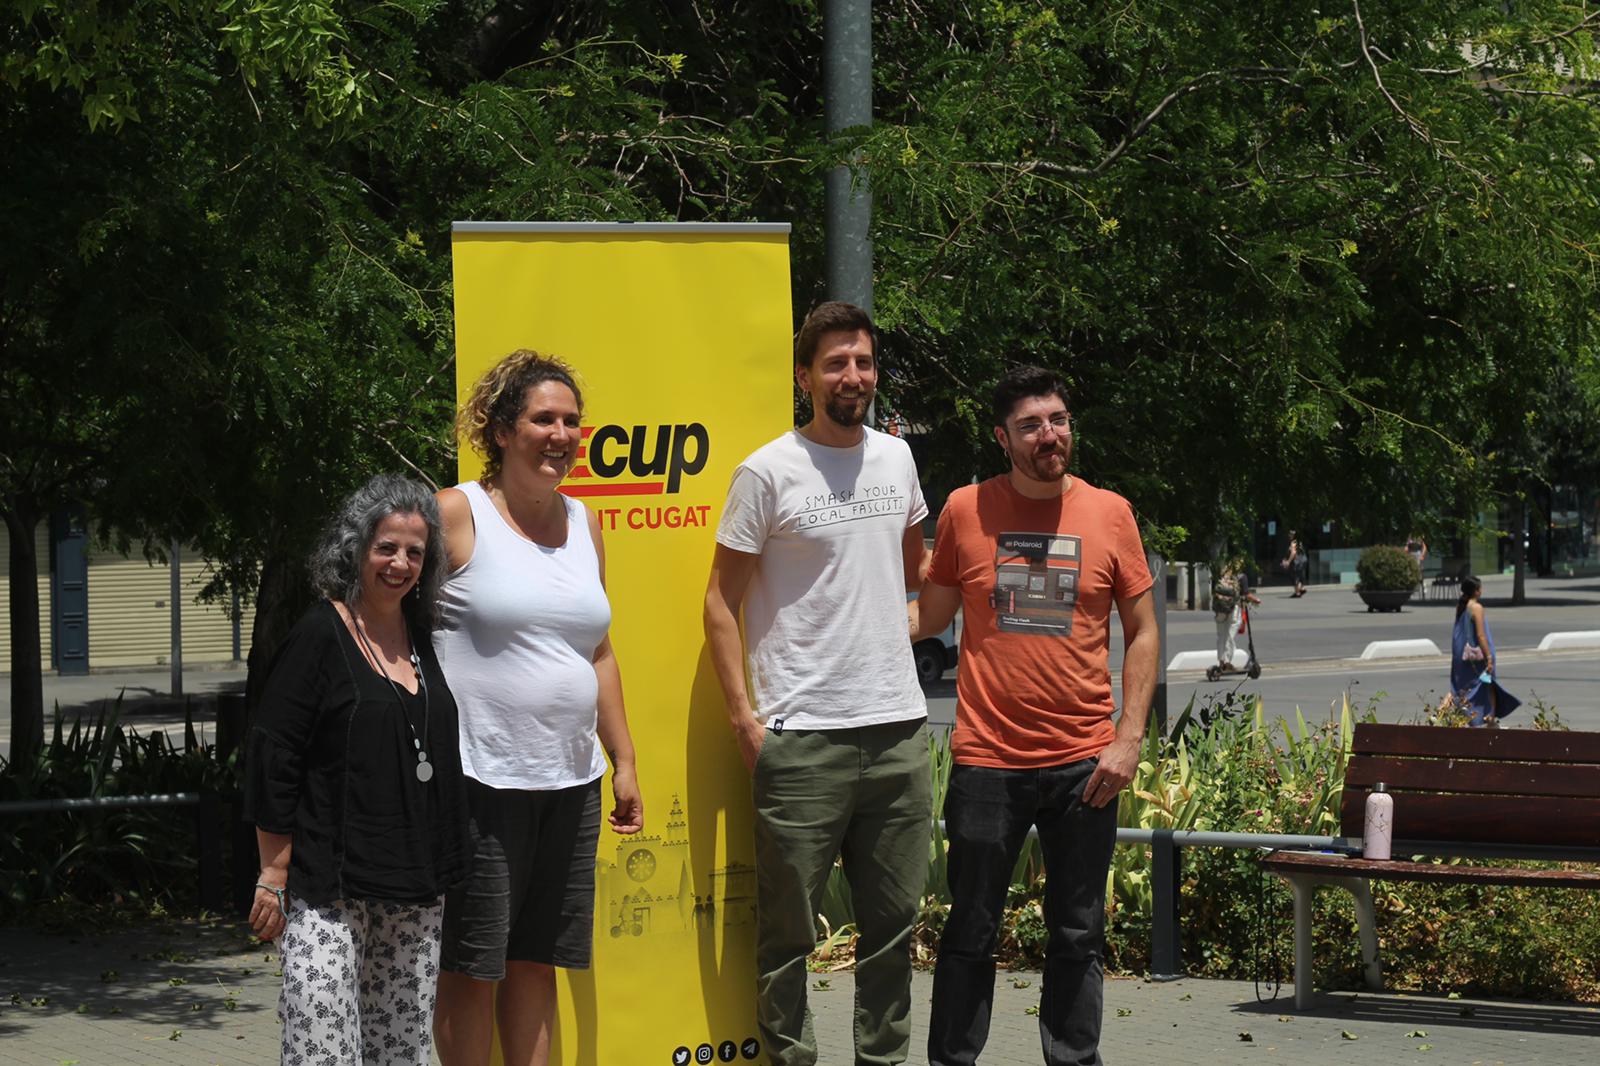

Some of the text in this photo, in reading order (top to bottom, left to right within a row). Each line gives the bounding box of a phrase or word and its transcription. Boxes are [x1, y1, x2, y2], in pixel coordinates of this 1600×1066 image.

[590, 422, 710, 494] cup
[805, 485, 896, 510] SMASH YOUR
[627, 505, 711, 530] CUGAT
[798, 510, 846, 527] LOCAL
[1013, 541, 1042, 549] Polaroid
